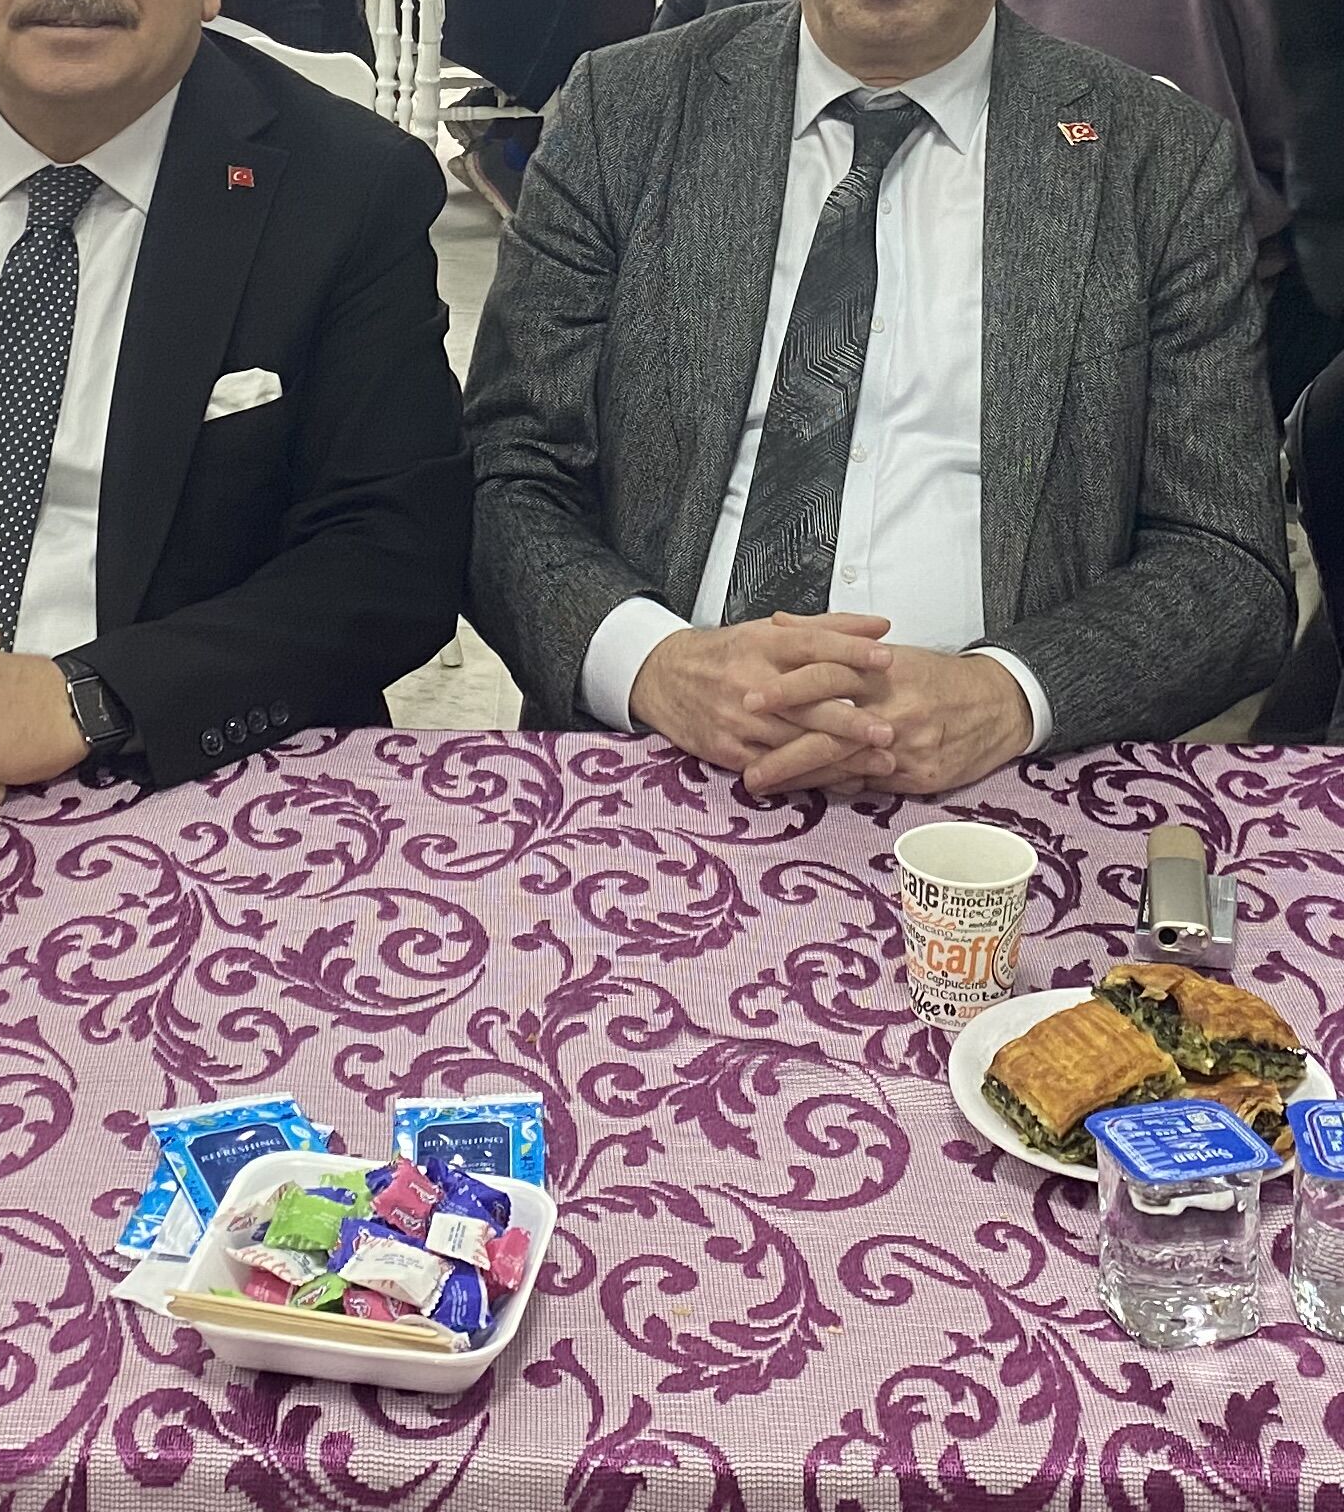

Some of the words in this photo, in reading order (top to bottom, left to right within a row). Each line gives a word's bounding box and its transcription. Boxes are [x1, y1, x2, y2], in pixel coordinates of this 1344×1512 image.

[941, 901, 976, 919] latte
[950, 894, 1003, 908] mocha
[926, 970, 987, 989] Cappuccino
